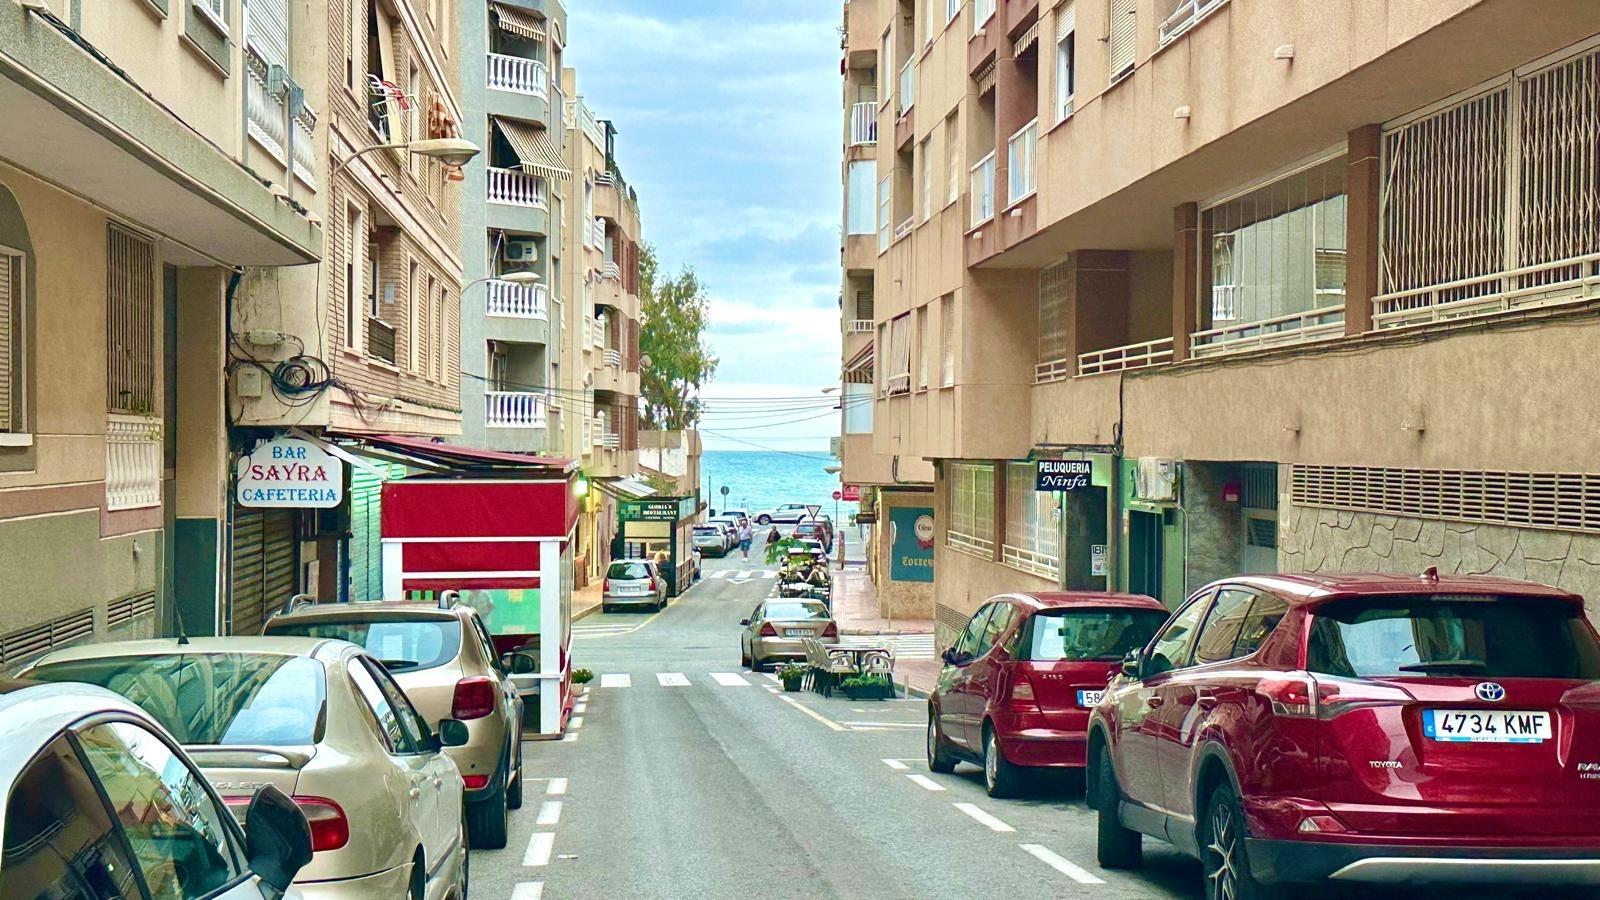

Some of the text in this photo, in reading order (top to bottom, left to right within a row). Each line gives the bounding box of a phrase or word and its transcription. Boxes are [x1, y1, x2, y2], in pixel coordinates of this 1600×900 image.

[272, 446, 306, 459] BAR
[251, 462, 329, 482] SAYRA
[1039, 461, 1090, 473] PELUQUERIA
[1041, 474, 1087, 490] Ninfa
[242, 488, 337, 502] CAFETERIA
[1085, 692, 1102, 704] 58
[1442, 713, 1496, 734] 4734
[1504, 714, 1544, 735] KMF
[1368, 760, 1403, 769] TOYOTA
[1577, 762, 1600, 771] RAV
